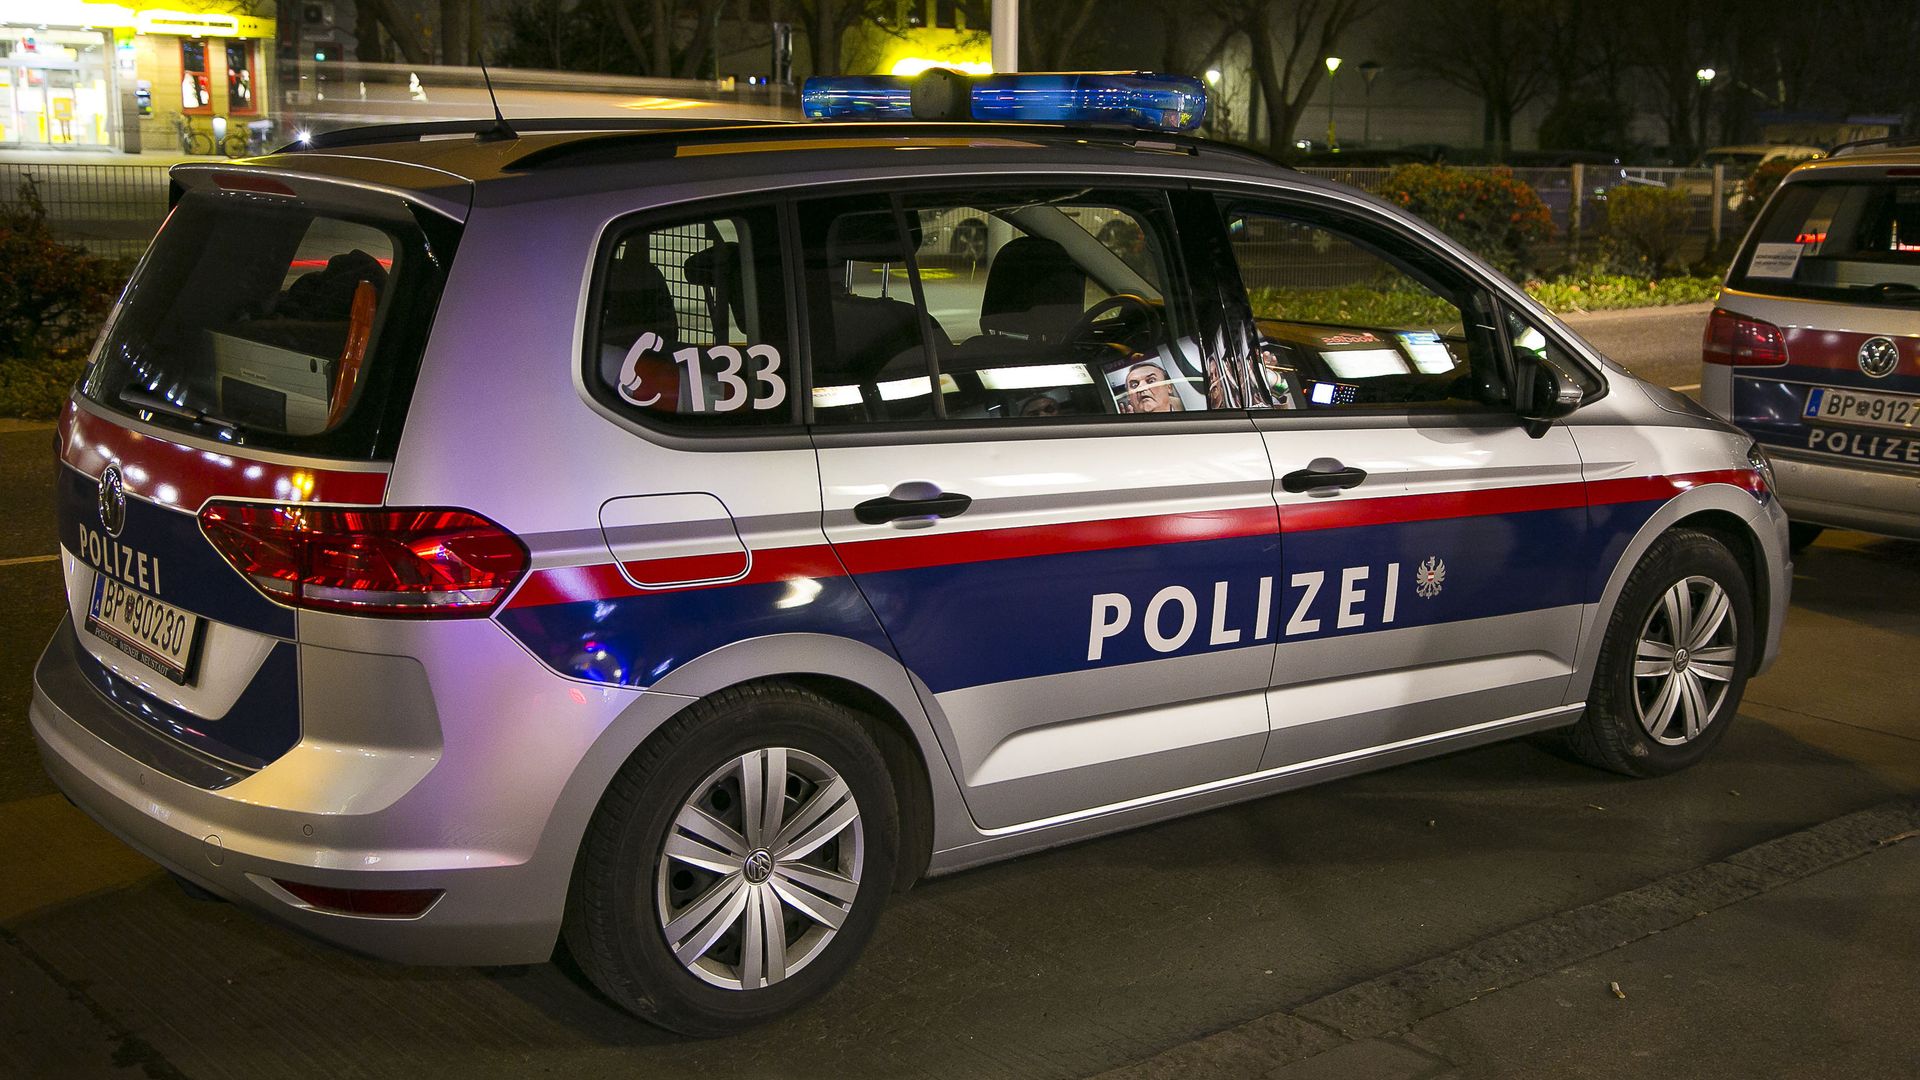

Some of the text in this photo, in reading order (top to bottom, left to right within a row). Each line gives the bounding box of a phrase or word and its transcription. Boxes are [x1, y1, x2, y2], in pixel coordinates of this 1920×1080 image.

[672, 344, 786, 412] 133
[1827, 394, 1855, 417] BP
[79, 523, 161, 595] POLIZEI
[104, 581, 186, 656] BP 90230
[1087, 562, 1400, 661] POLIZEI
[95, 628, 119, 645] PORSCHE
[140, 653, 170, 676] NEUSTADT
